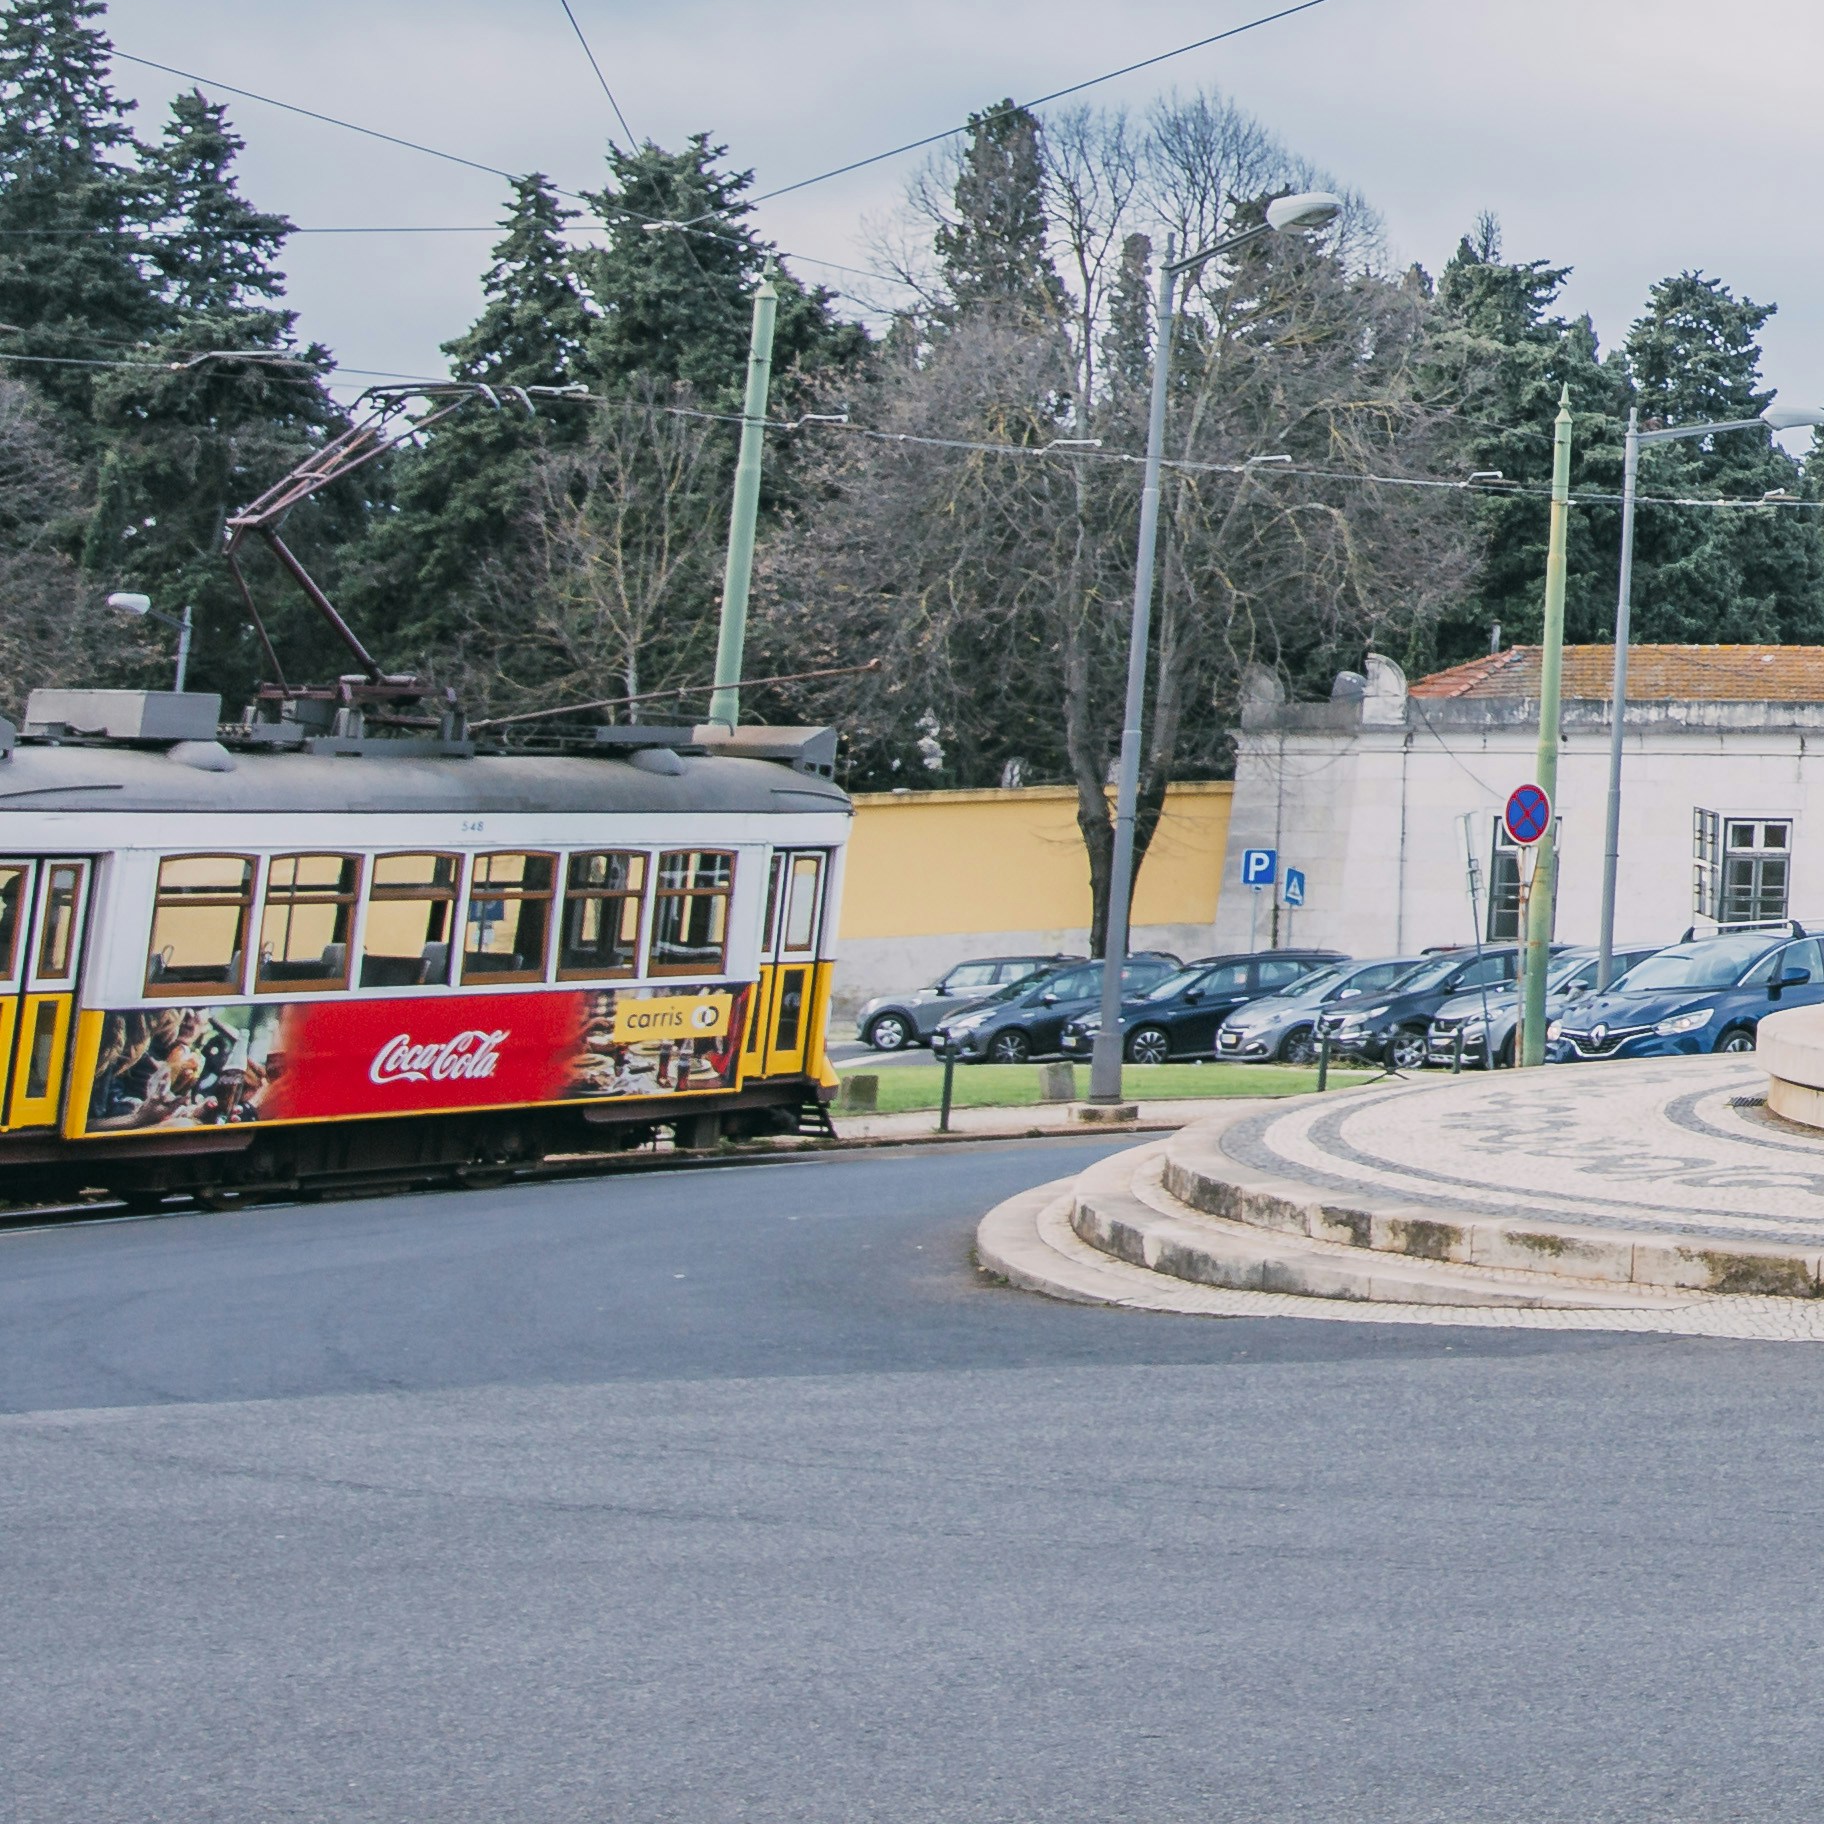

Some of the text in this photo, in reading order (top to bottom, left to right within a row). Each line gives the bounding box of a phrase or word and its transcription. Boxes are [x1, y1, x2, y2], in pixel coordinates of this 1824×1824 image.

[461, 821, 484, 831] 548
[1248, 852, 1270, 882] P
[626, 1005, 683, 1029] carris
[369, 1028, 511, 1085] Coca-Cola
